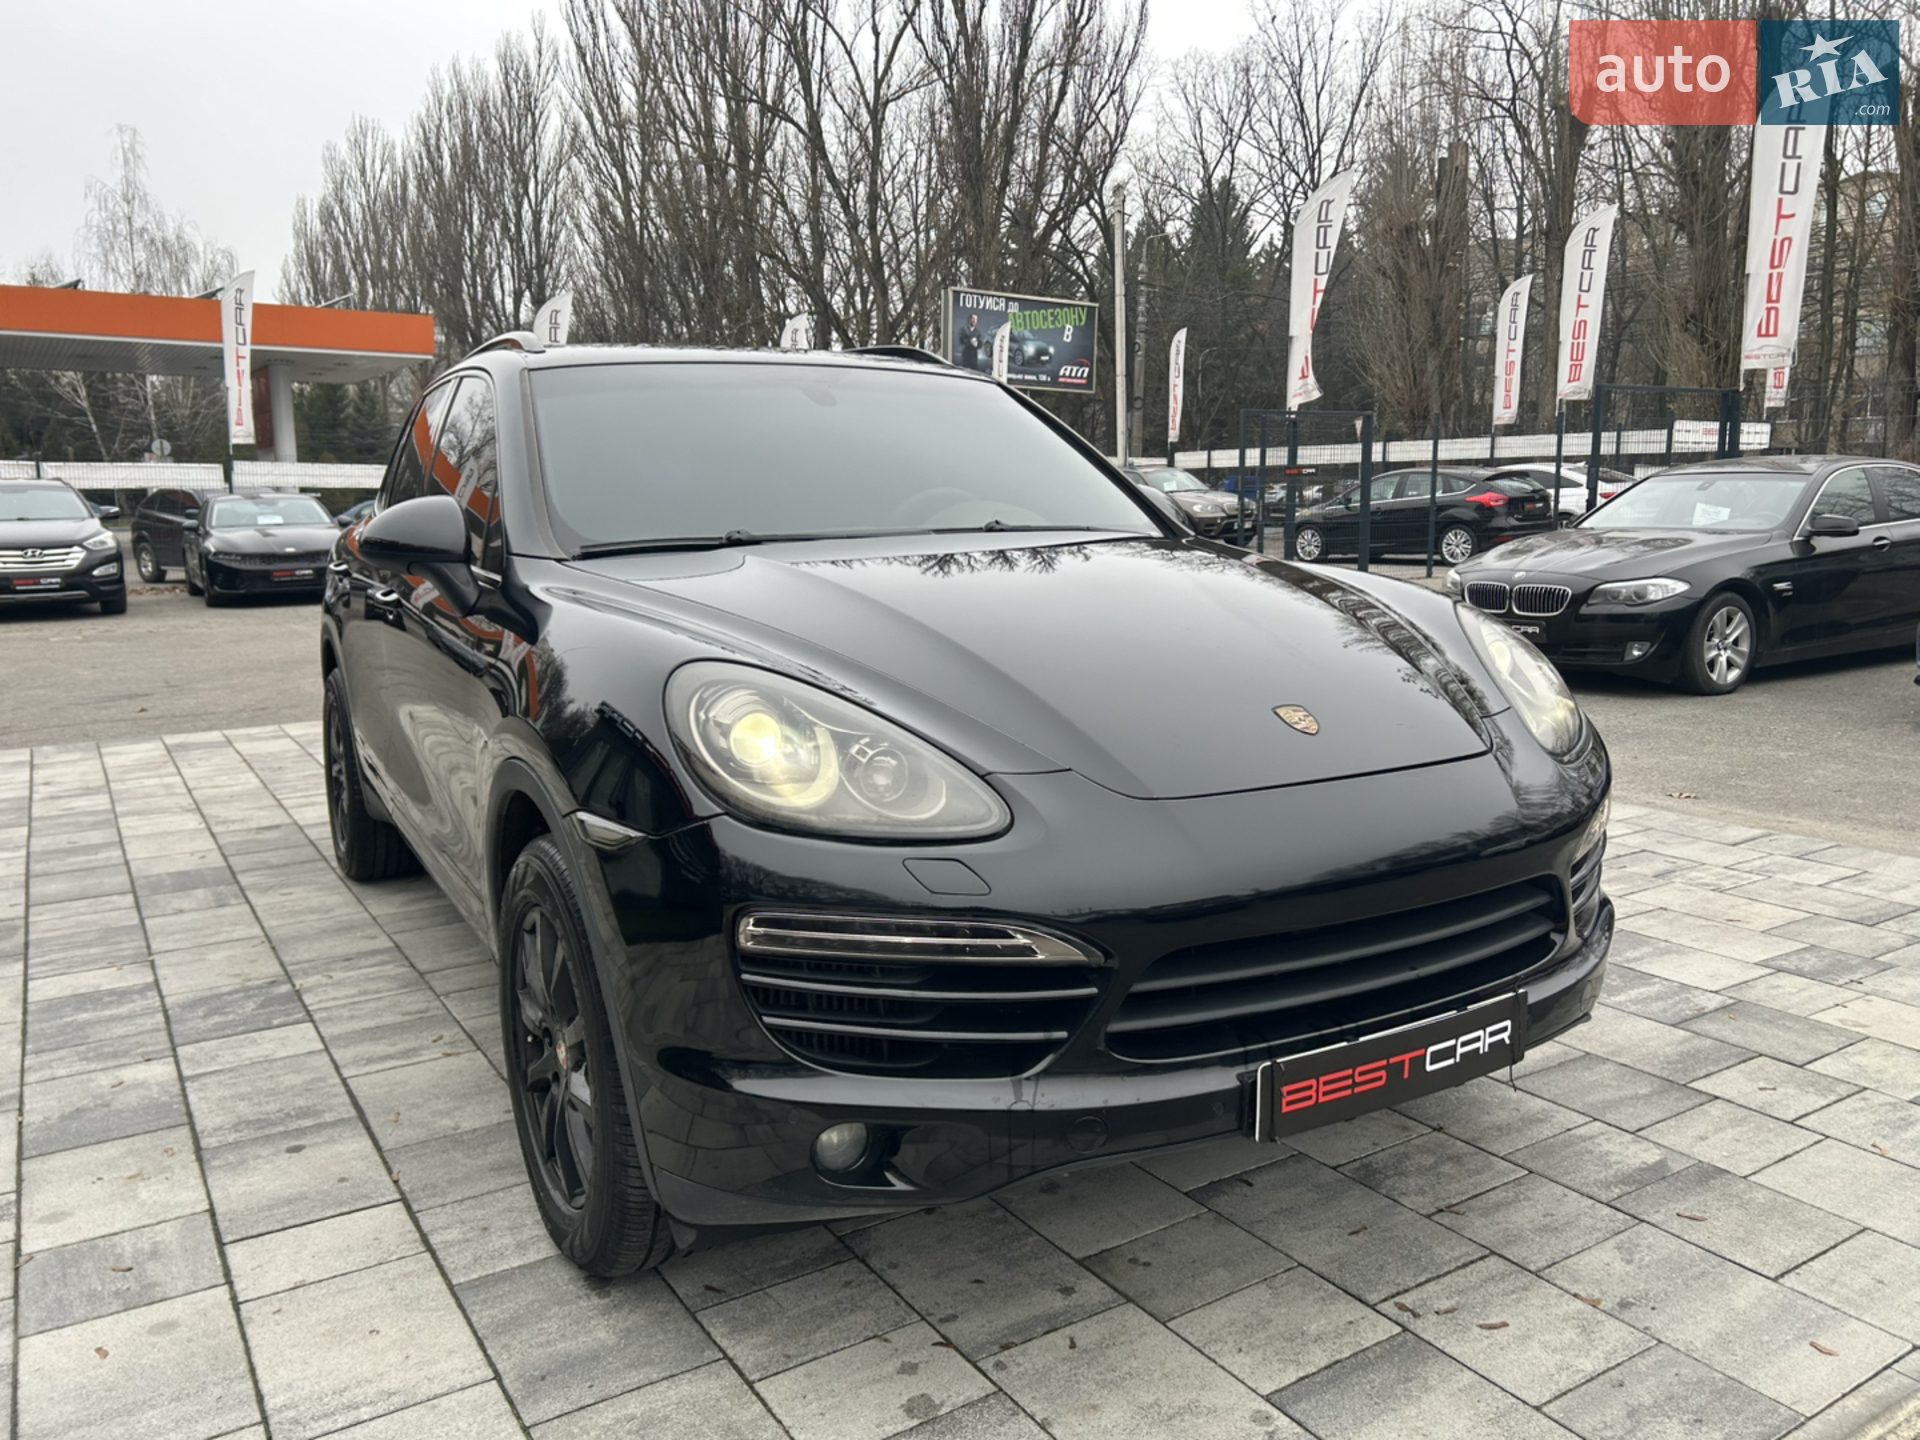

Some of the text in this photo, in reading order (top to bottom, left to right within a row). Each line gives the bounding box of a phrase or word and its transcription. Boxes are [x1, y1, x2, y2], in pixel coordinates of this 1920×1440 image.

[1008, 306, 1087, 331] АВТОСЕЗОНУ
[1503, 291, 1521, 410] BESTCAR
[1568, 226, 1601, 383] BESTCAR
[1281, 1019, 1512, 1114] BESTCAR
